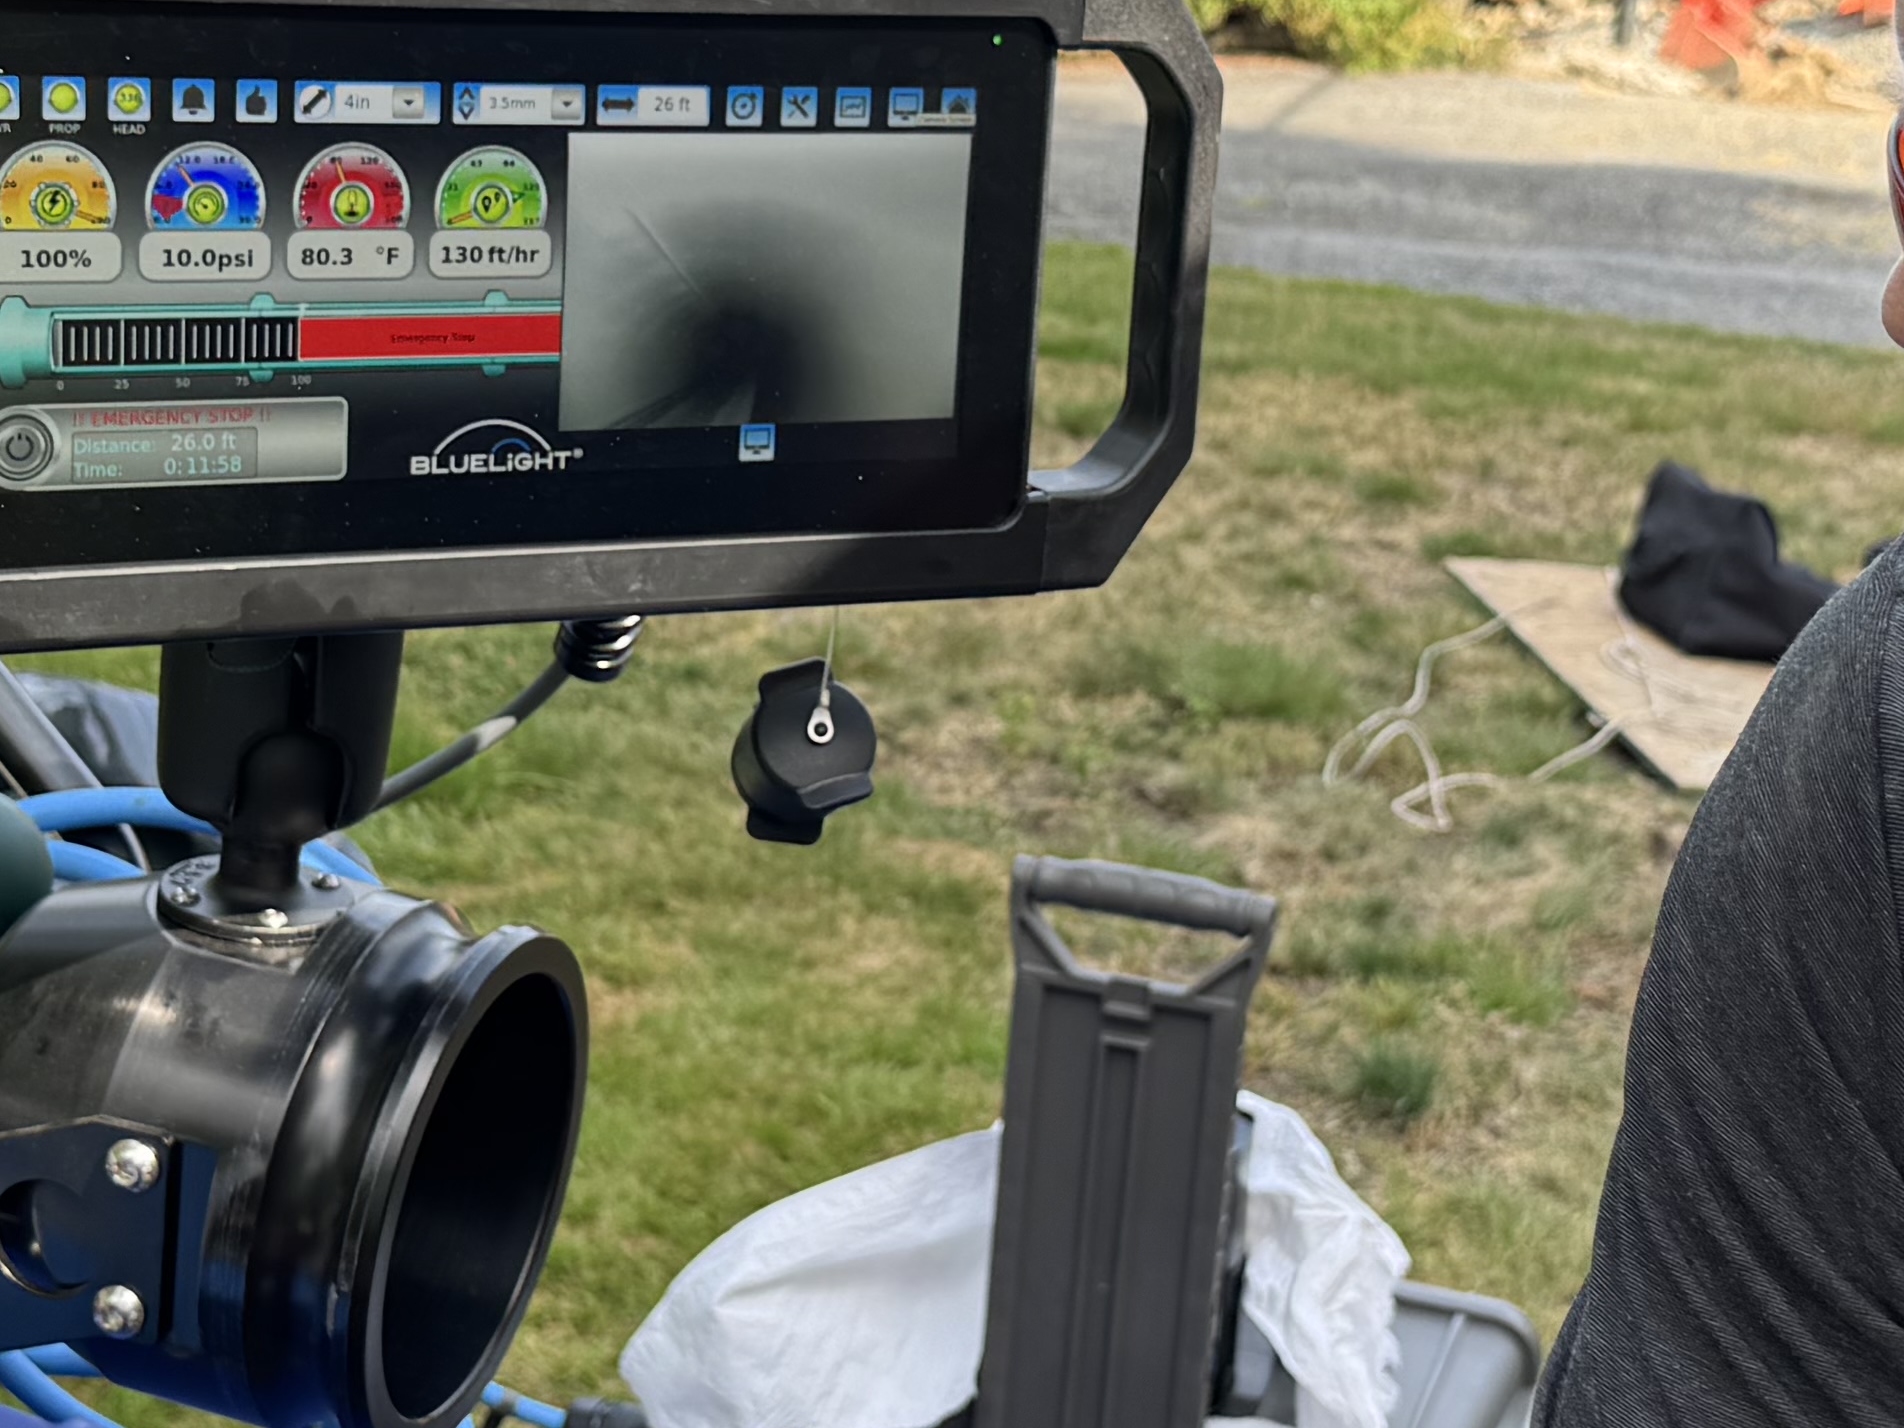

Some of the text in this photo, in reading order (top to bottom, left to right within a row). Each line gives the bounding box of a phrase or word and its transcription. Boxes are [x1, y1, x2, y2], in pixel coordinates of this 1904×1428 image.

[344, 94, 371, 110] 4in
[489, 97, 537, 110] 3.5mm
[654, 96, 691, 113] 26 ft
[113, 124, 147, 135] HEAD
[21, 249, 92, 268] 100%
[162, 249, 254, 272] 10.0psi
[301, 246, 400, 265] 80.3 °F
[441, 245, 540, 265] 130 ft/hr
[91, 409, 202, 427] EMERGENCY
[208, 407, 254, 424] STOP
[171, 433, 215, 451] 26.0
[221, 432, 237, 449] ft
[73, 461, 123, 477] Time:
